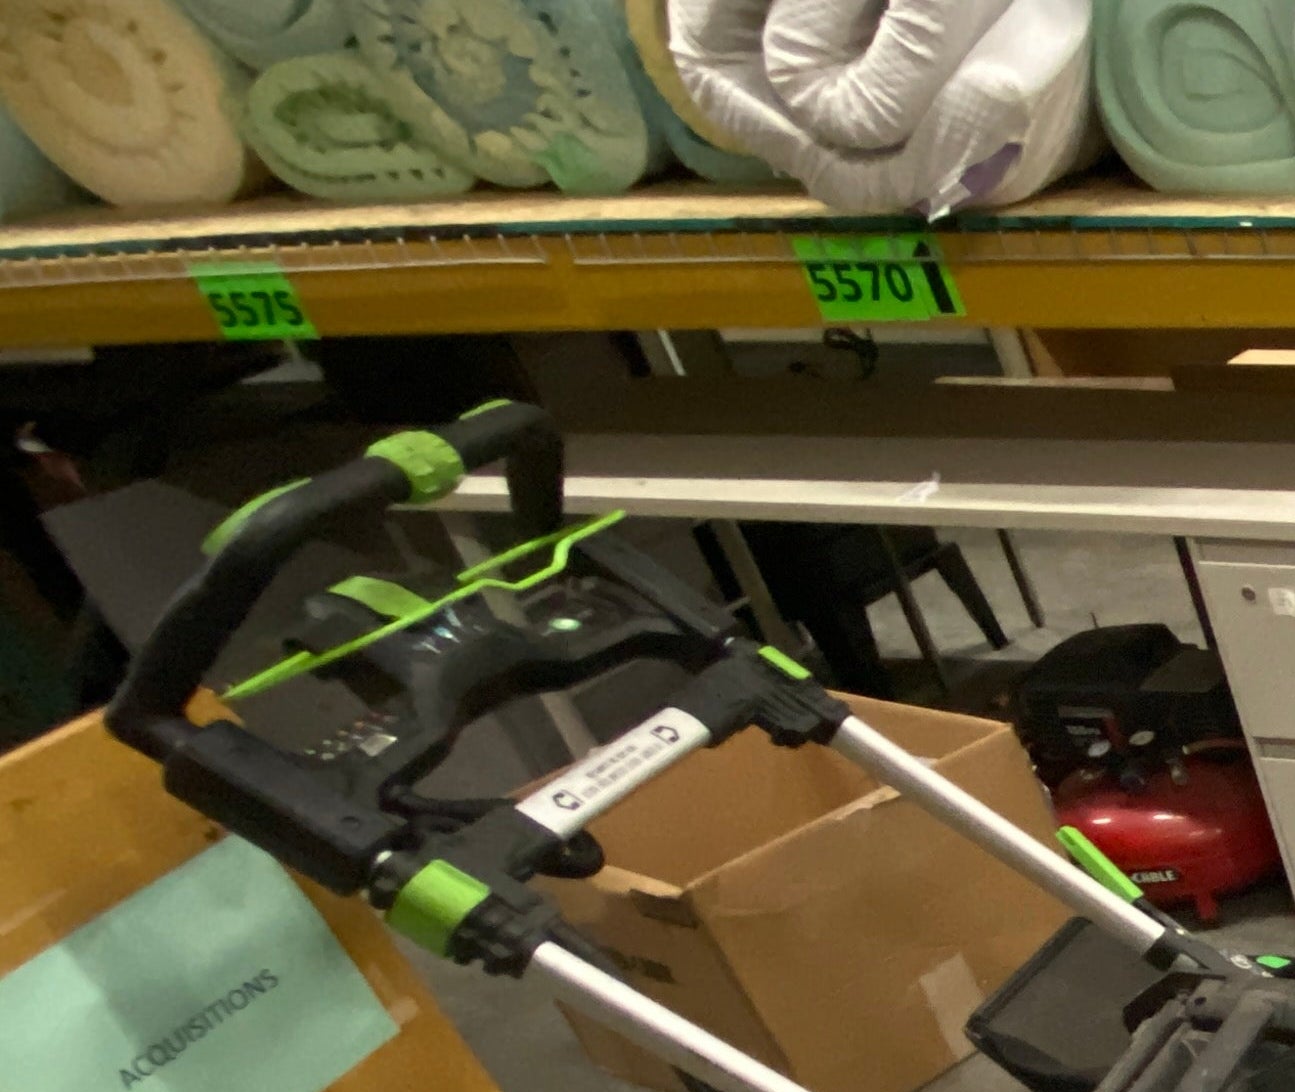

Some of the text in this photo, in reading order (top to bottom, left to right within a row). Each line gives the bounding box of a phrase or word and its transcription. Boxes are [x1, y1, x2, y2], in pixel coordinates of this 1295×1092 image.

[804, 262, 914, 302] 5570
[207, 290, 304, 328] 5575
[118, 968, 279, 1091] ACQUISITIONS
